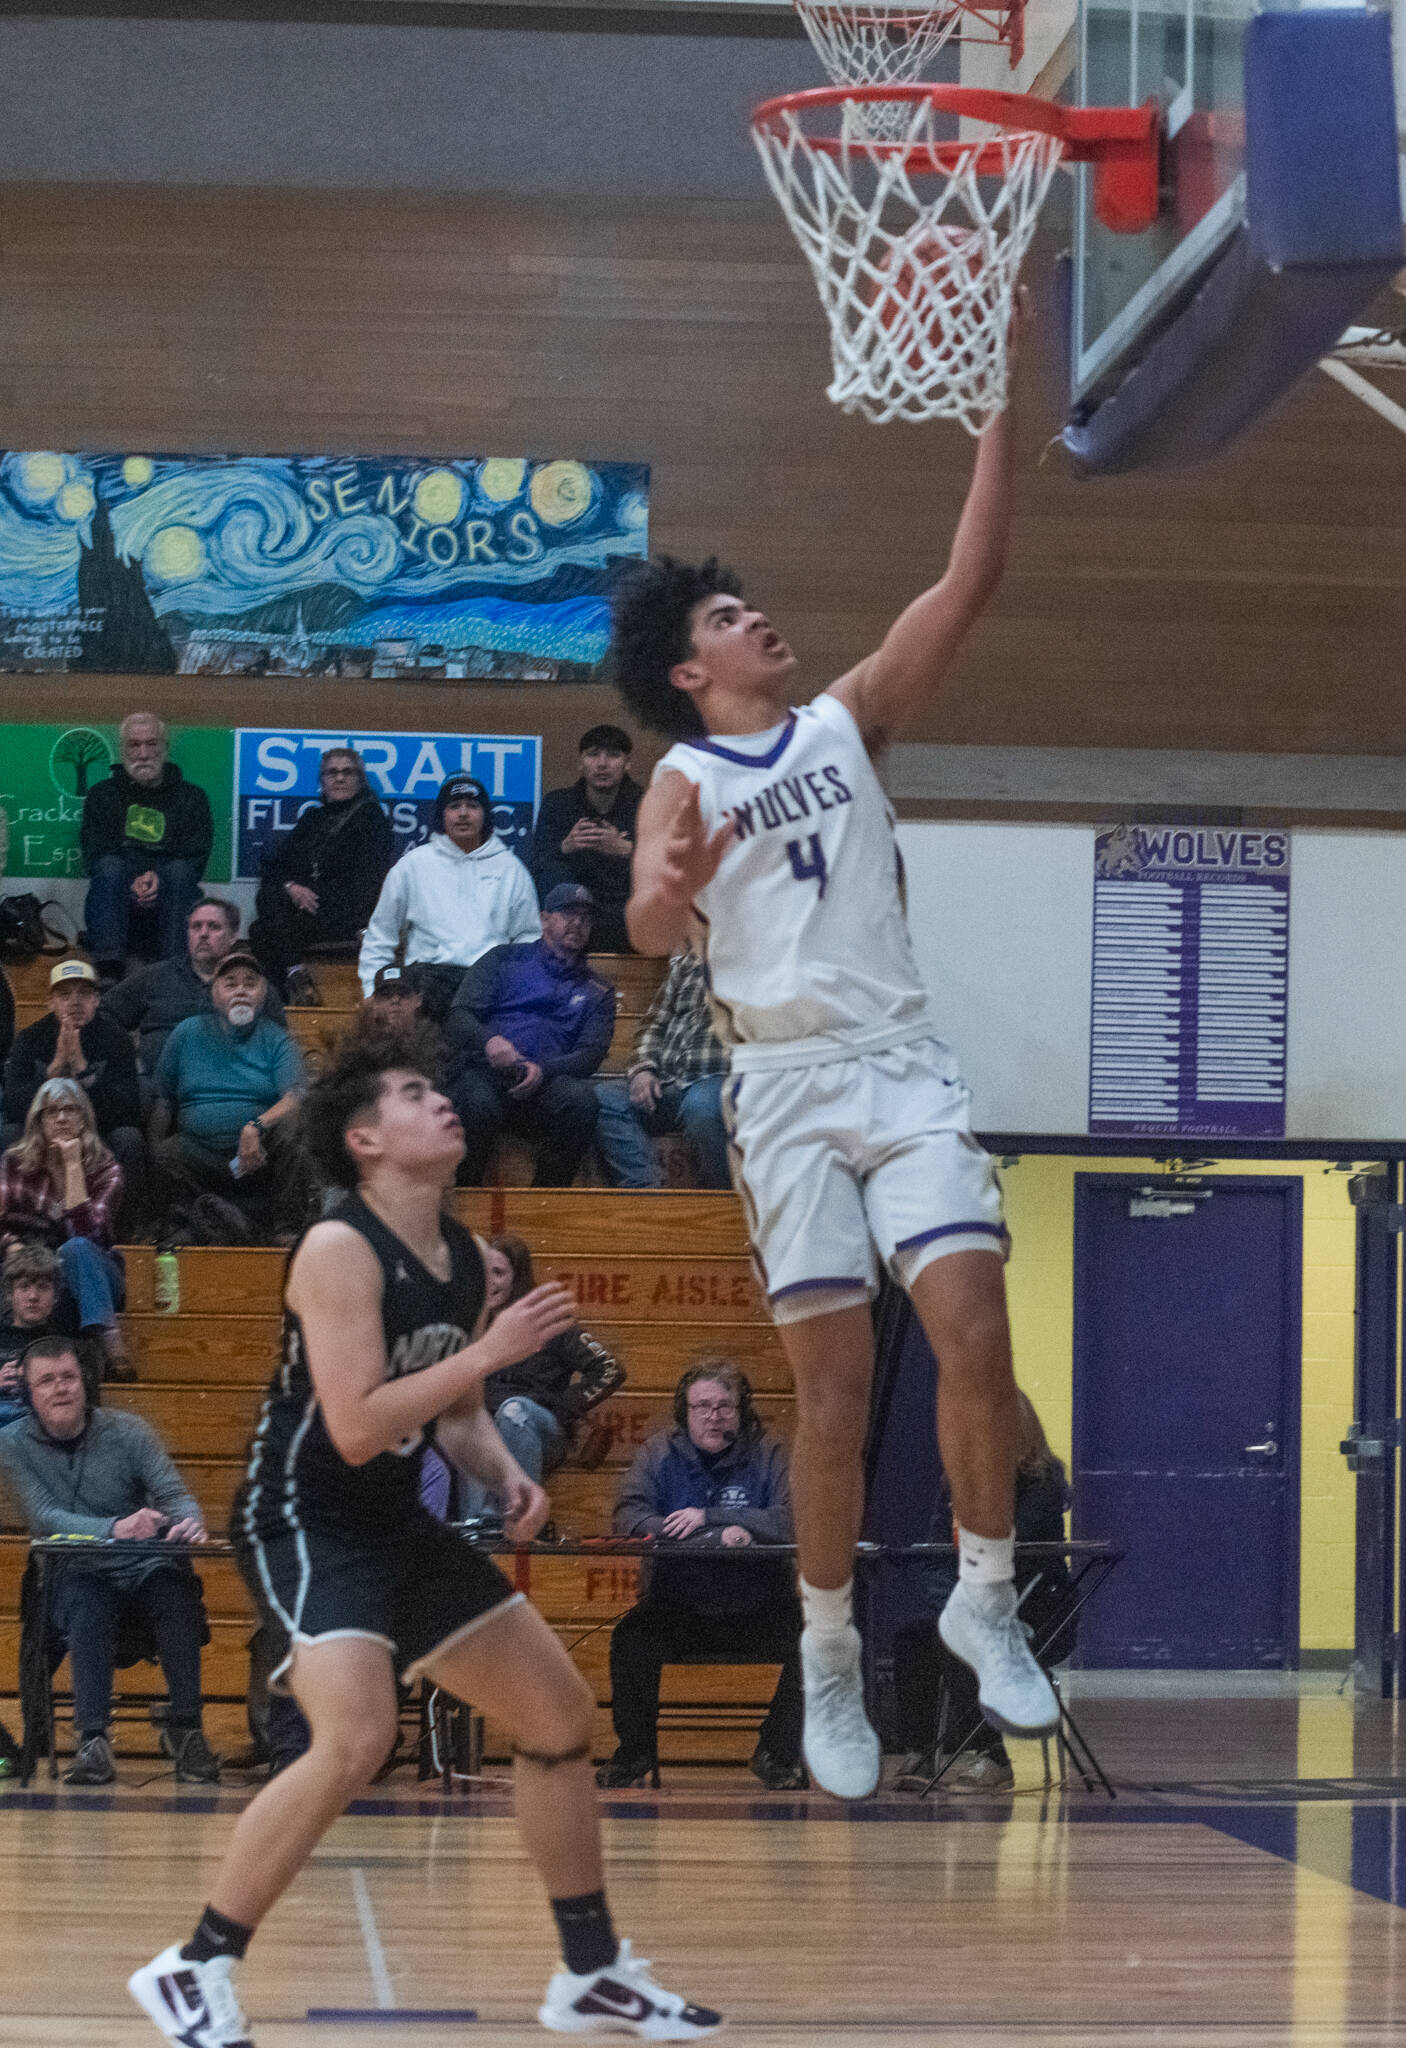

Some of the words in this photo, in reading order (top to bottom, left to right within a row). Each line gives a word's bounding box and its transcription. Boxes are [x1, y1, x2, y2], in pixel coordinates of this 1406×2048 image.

[786, 833, 826, 901] 4
[1140, 830, 1287, 868] WOLVES
[652, 1274, 751, 1306] AISLE
